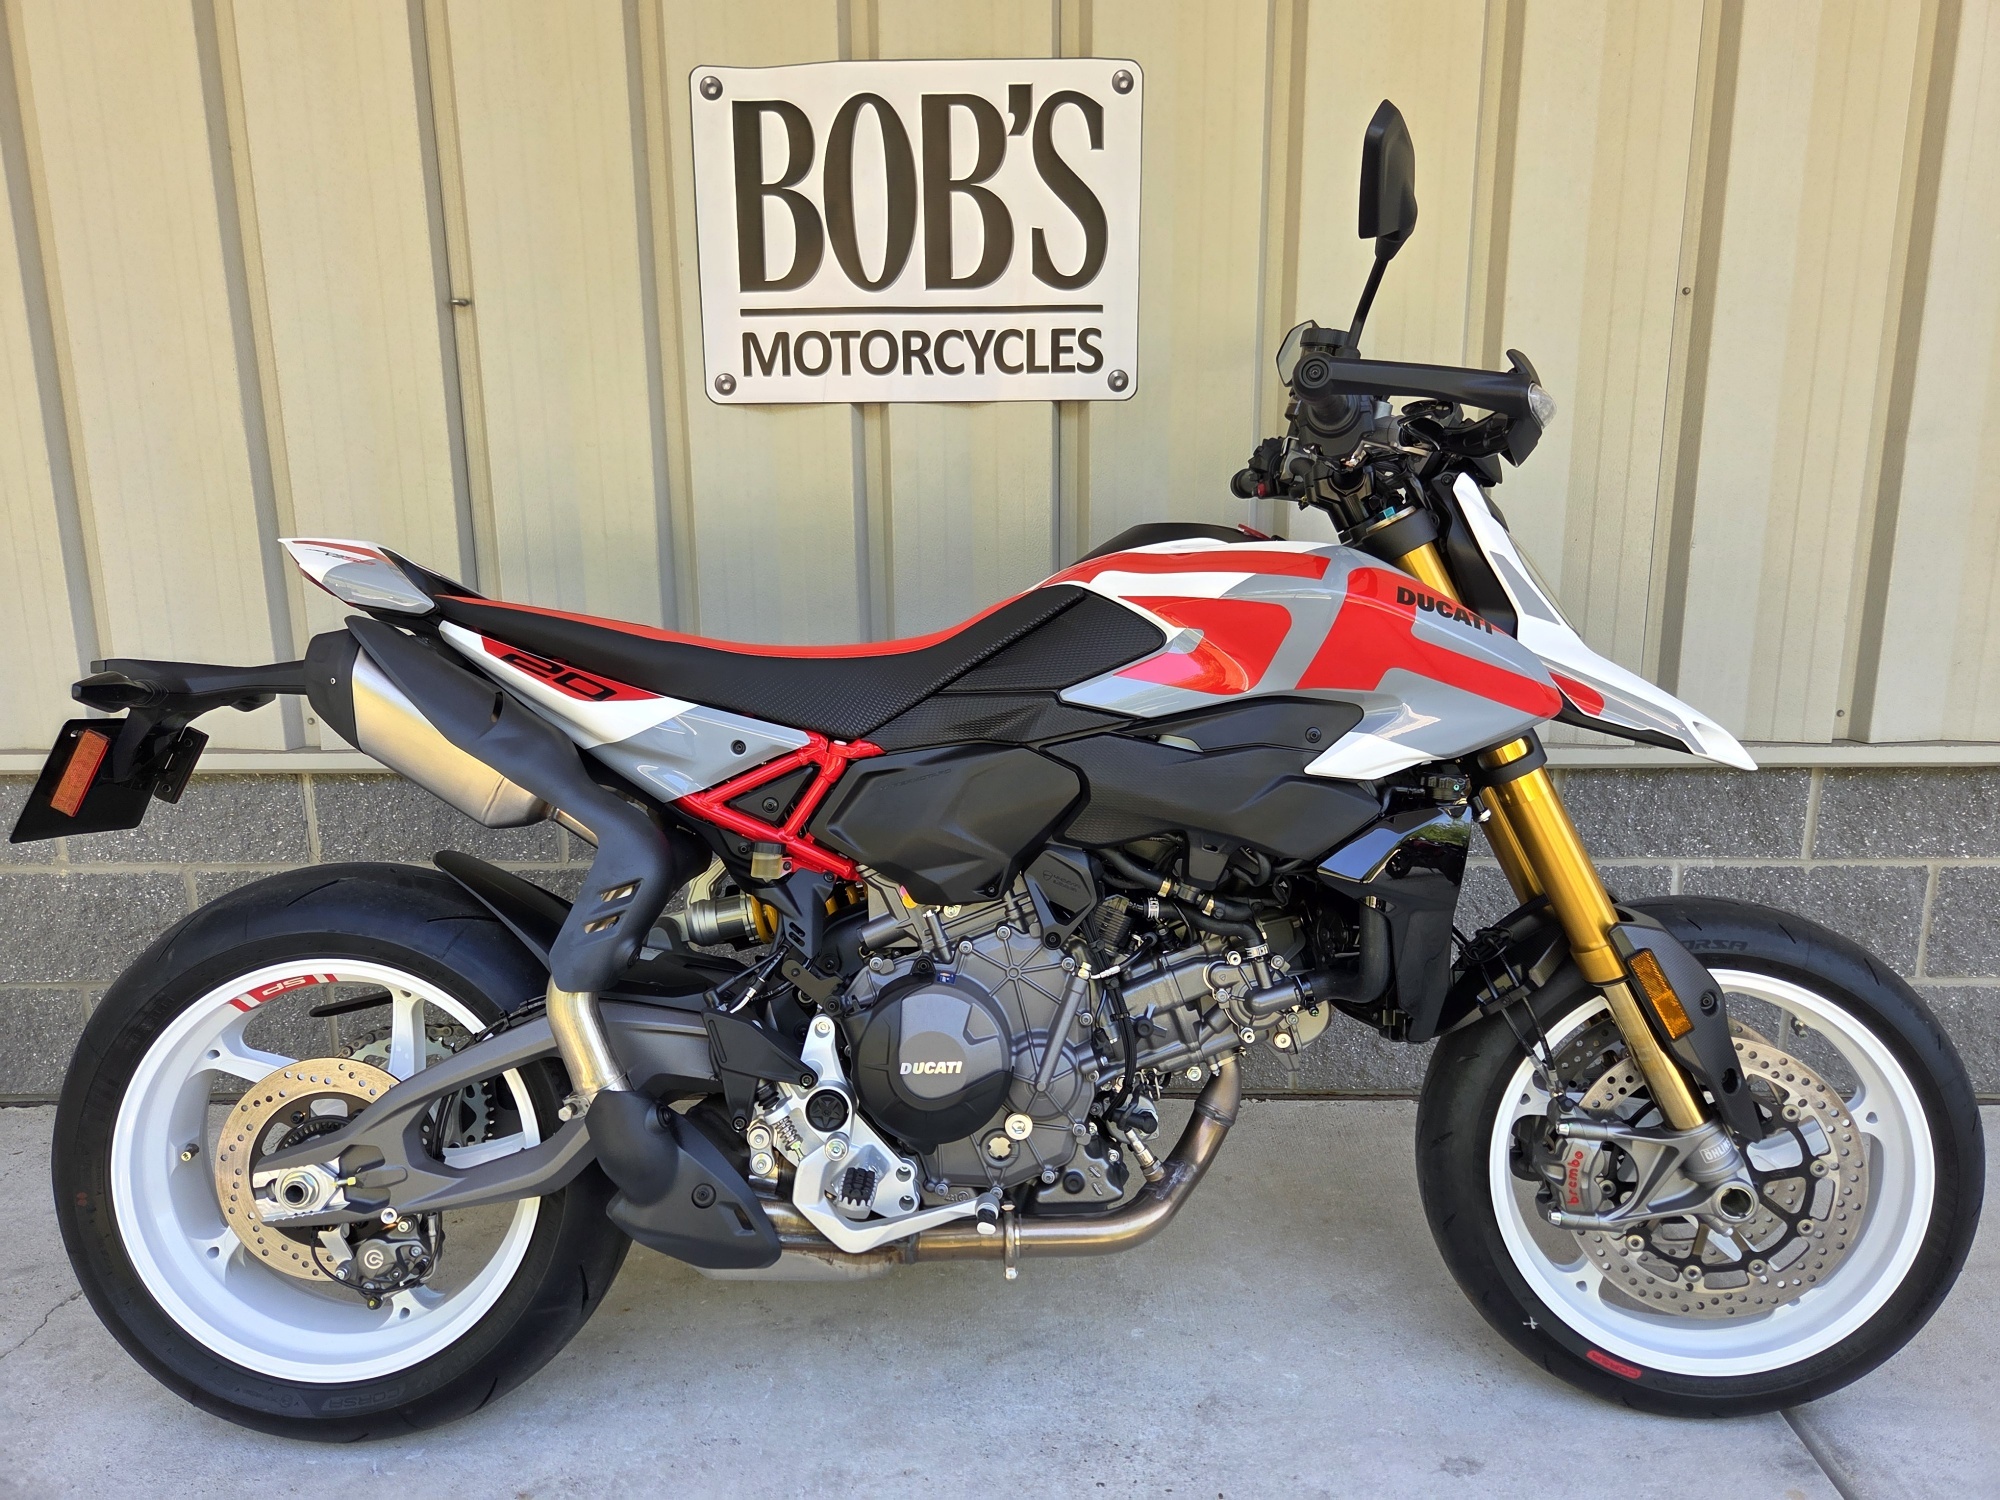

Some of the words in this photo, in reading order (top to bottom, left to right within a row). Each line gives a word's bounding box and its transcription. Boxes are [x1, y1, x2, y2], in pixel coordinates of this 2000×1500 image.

[732, 83, 1108, 293] BOB'S
[742, 327, 1103, 376] MOTORCYCLES
[1396, 586, 1493, 635] DUCATI
[262, 976, 306, 996] SP
[900, 1061, 963, 1075] DUCATI
[1567, 1151, 1583, 1204] brembo
